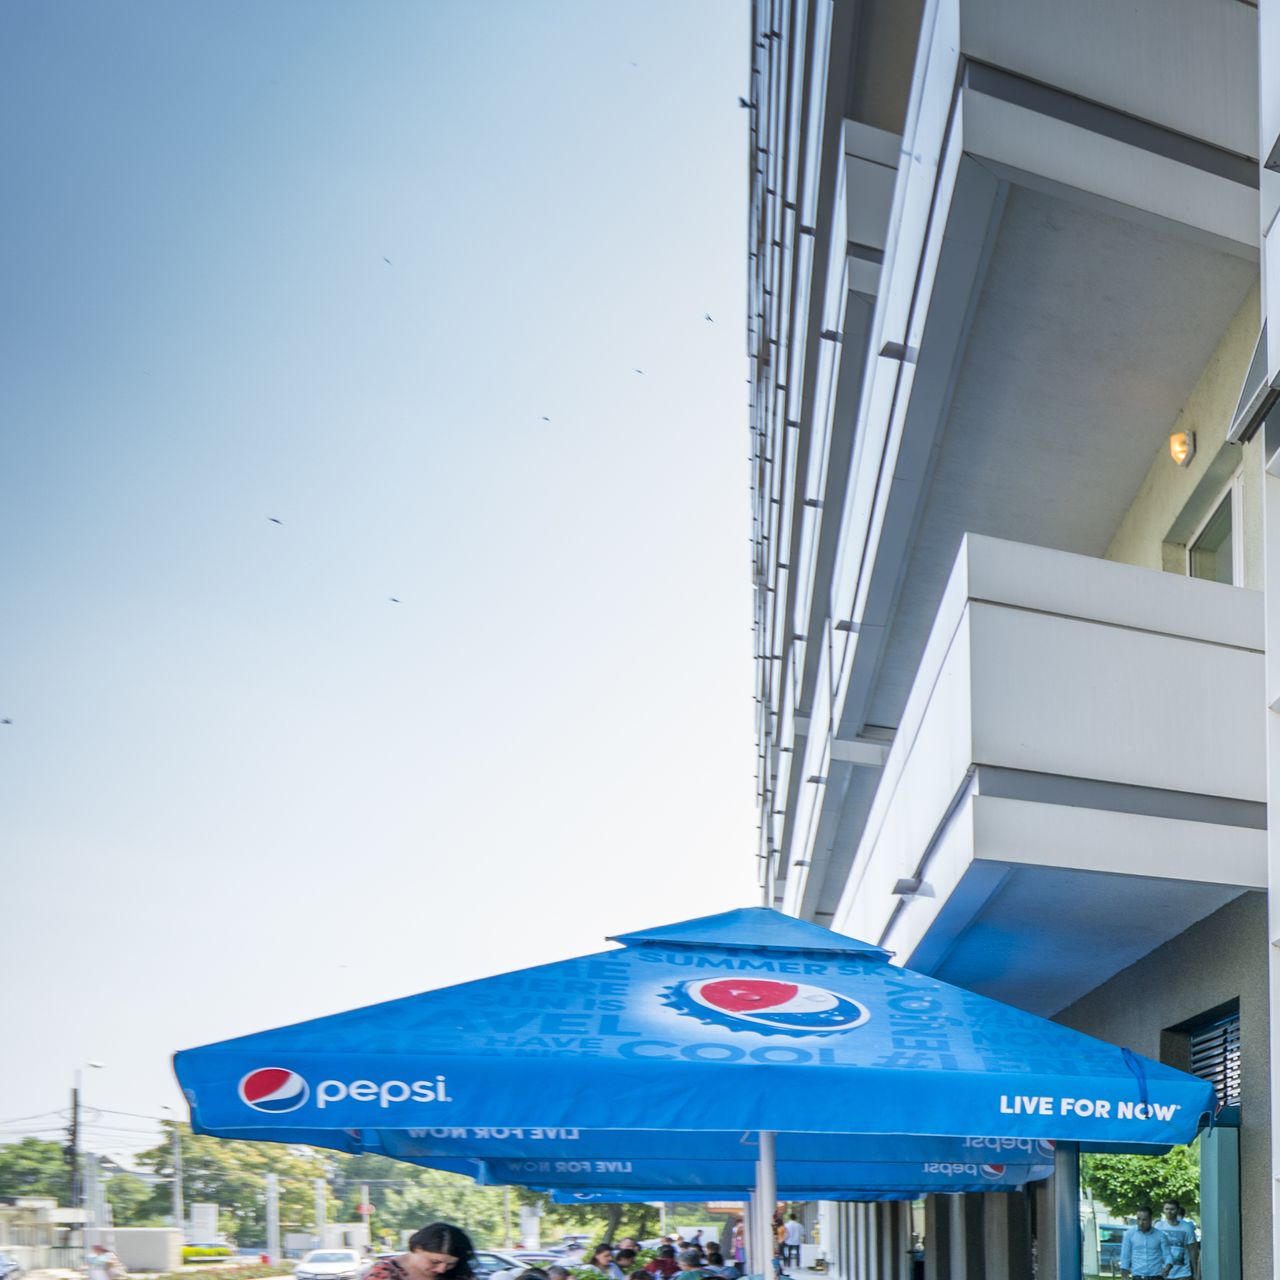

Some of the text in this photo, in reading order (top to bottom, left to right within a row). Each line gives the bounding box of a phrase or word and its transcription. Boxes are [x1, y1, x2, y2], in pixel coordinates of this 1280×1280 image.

[637, 952, 826, 975] SUMMER
[484, 1035, 605, 1049] HAVE
[617, 1040, 857, 1068] COOL
[316, 1075, 446, 1109] pepsi
[1000, 1095, 1177, 1121] LIVE FOR NOW
